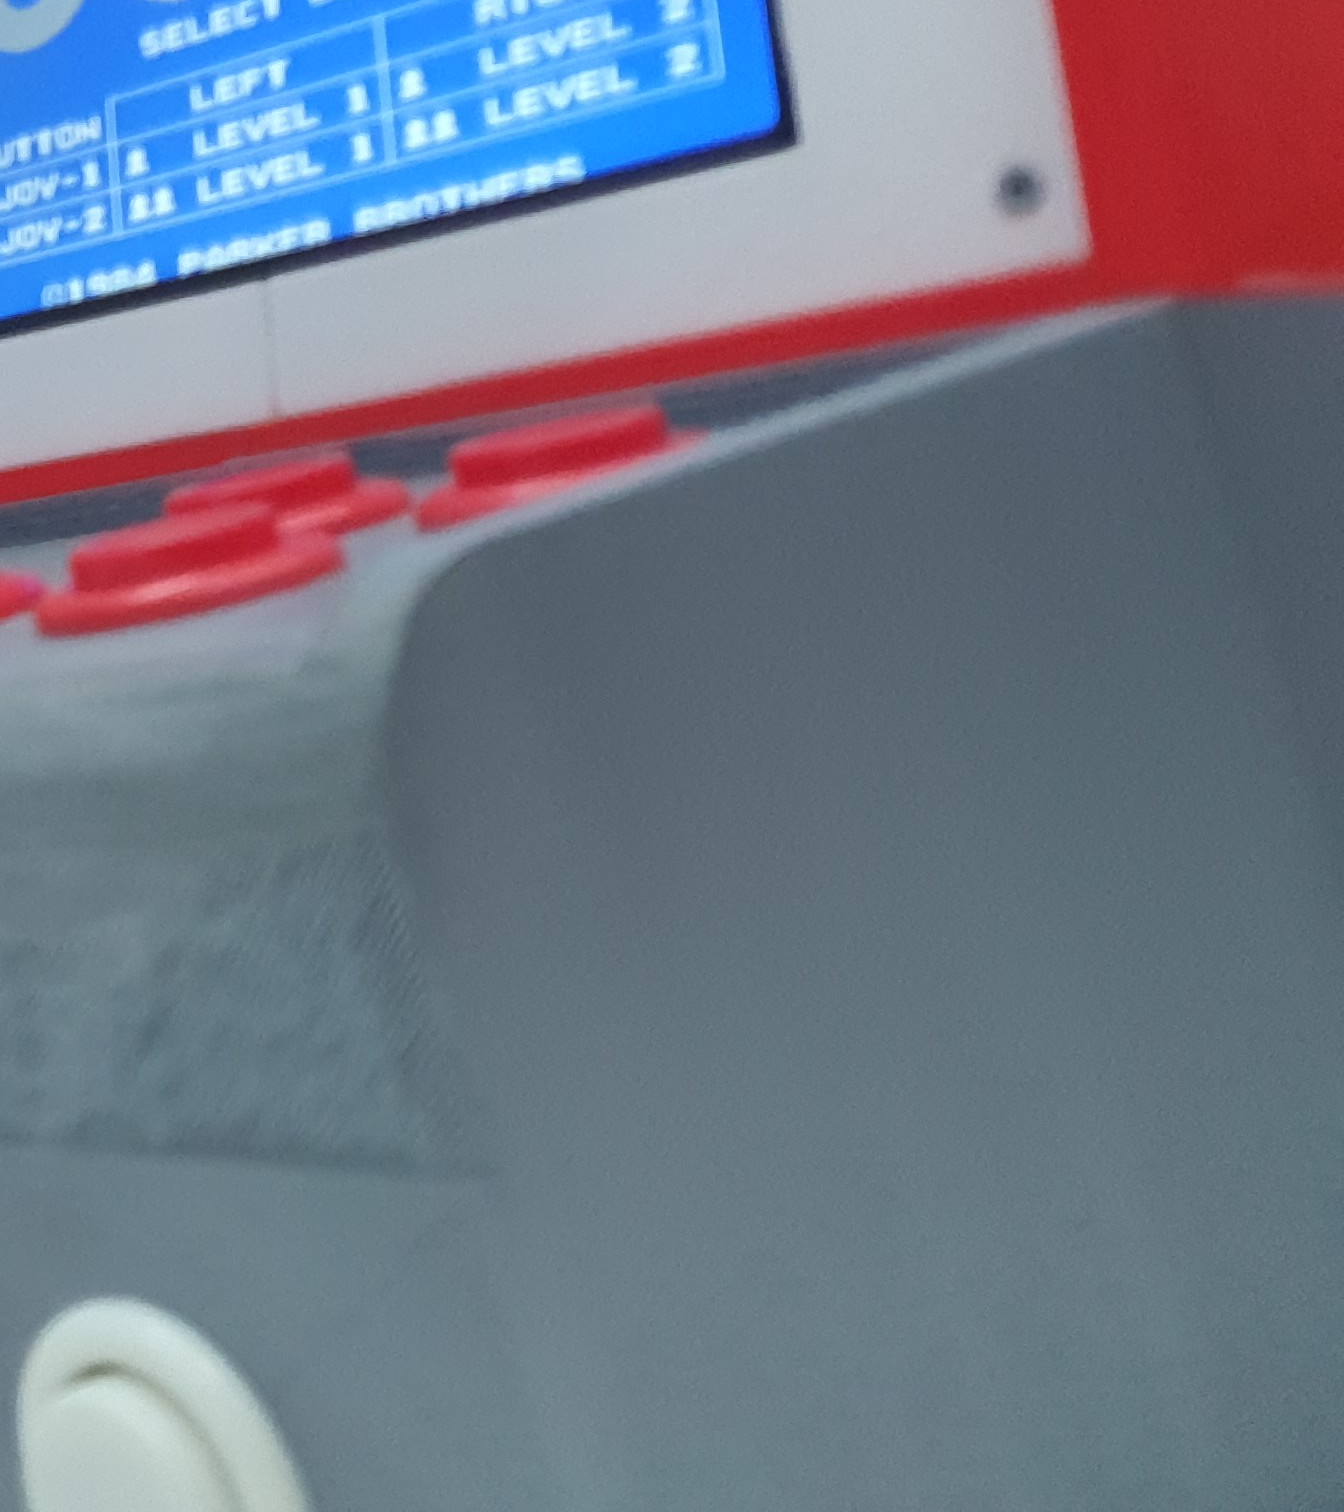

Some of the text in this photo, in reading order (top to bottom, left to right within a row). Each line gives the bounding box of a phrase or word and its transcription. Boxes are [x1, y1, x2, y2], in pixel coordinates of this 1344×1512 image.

[477, 12, 633, 76] LEVEL
[189, 58, 292, 113] LEFT
[192, 82, 370, 160] LEVEL 1
[483, 41, 701, 127] LEVEL 2
[195, 131, 375, 206] LEVEL 1
[177, 216, 332, 278] PARKER
[353, 154, 587, 236] BROTHERS
